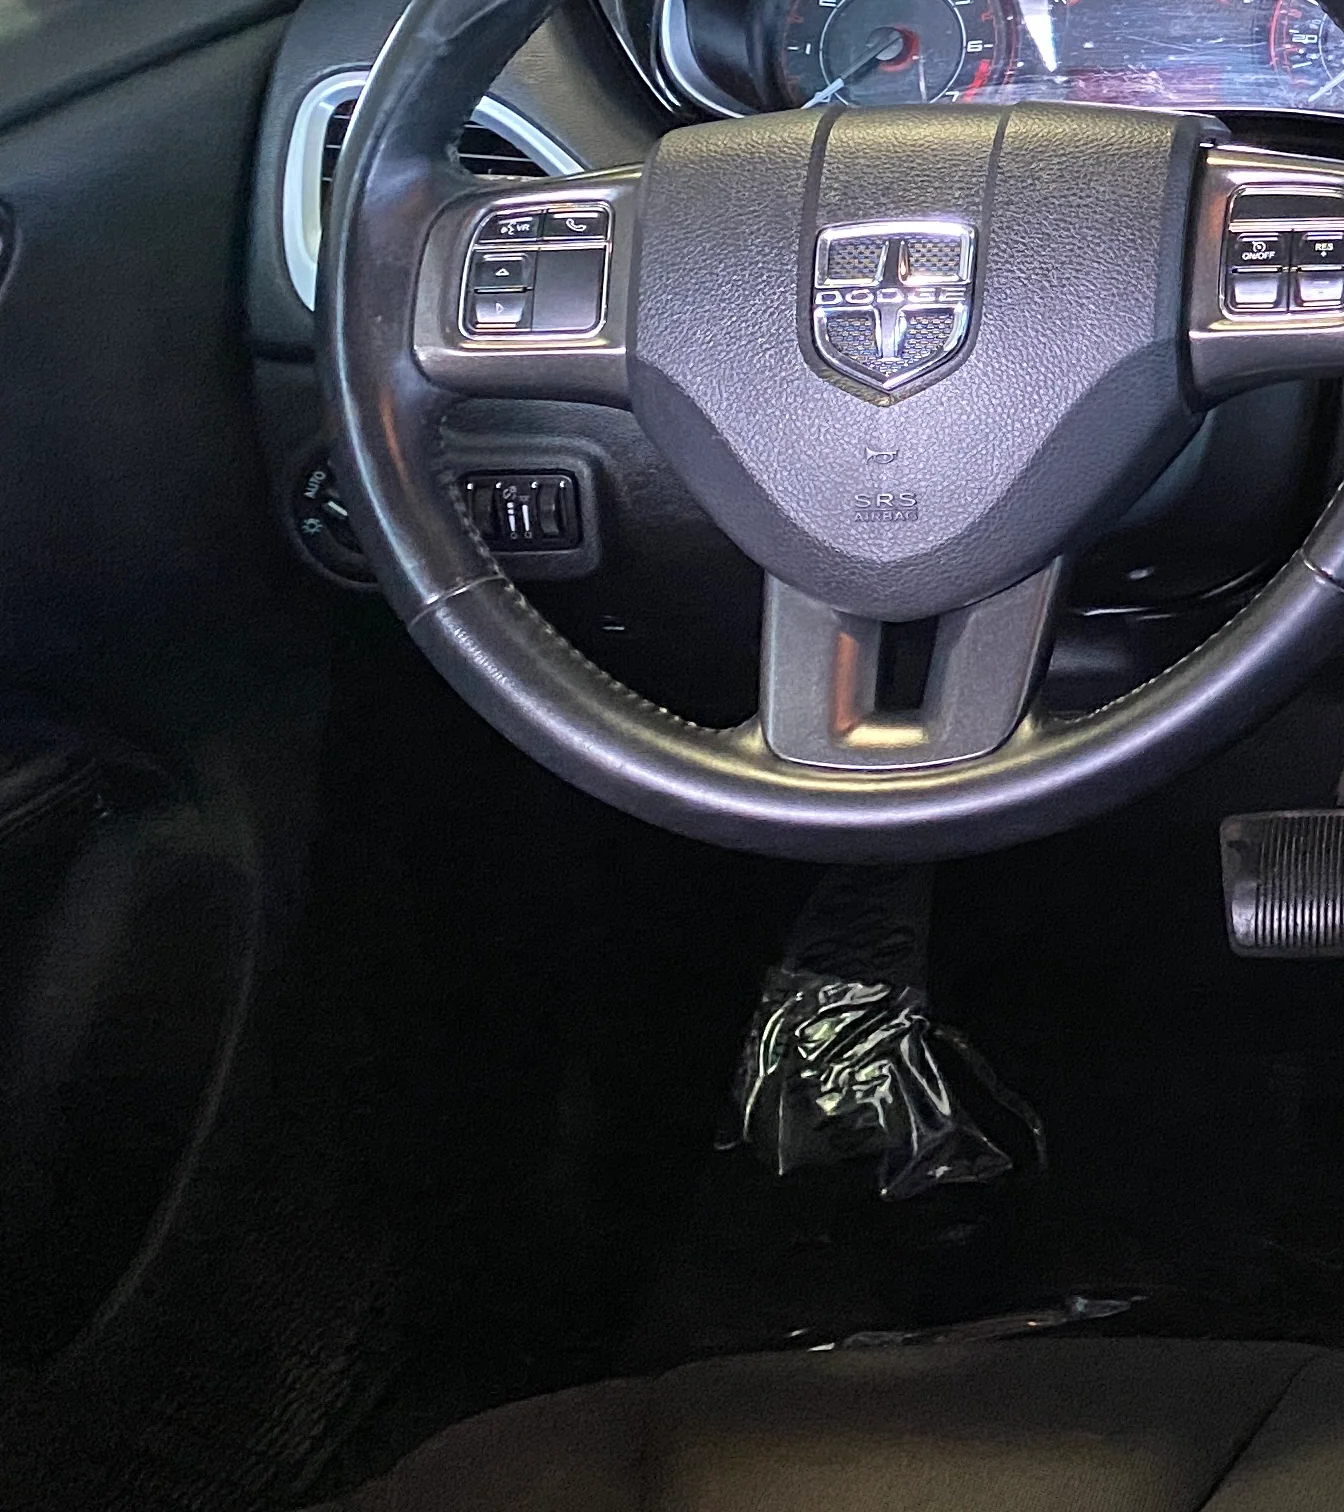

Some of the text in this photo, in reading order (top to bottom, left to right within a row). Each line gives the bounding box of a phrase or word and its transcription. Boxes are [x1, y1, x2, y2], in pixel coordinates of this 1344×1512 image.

[1291, 33, 1318, 44] 20
[966, 40, 983, 52] 6
[945, 90, 960, 102] 7
[1315, 242, 1334, 251] RES
[1242, 251, 1276, 261] ON/OFF
[815, 287, 967, 305] DODGE
[854, 492, 918, 508] SRS
[854, 510, 919, 523] AIRBAG
